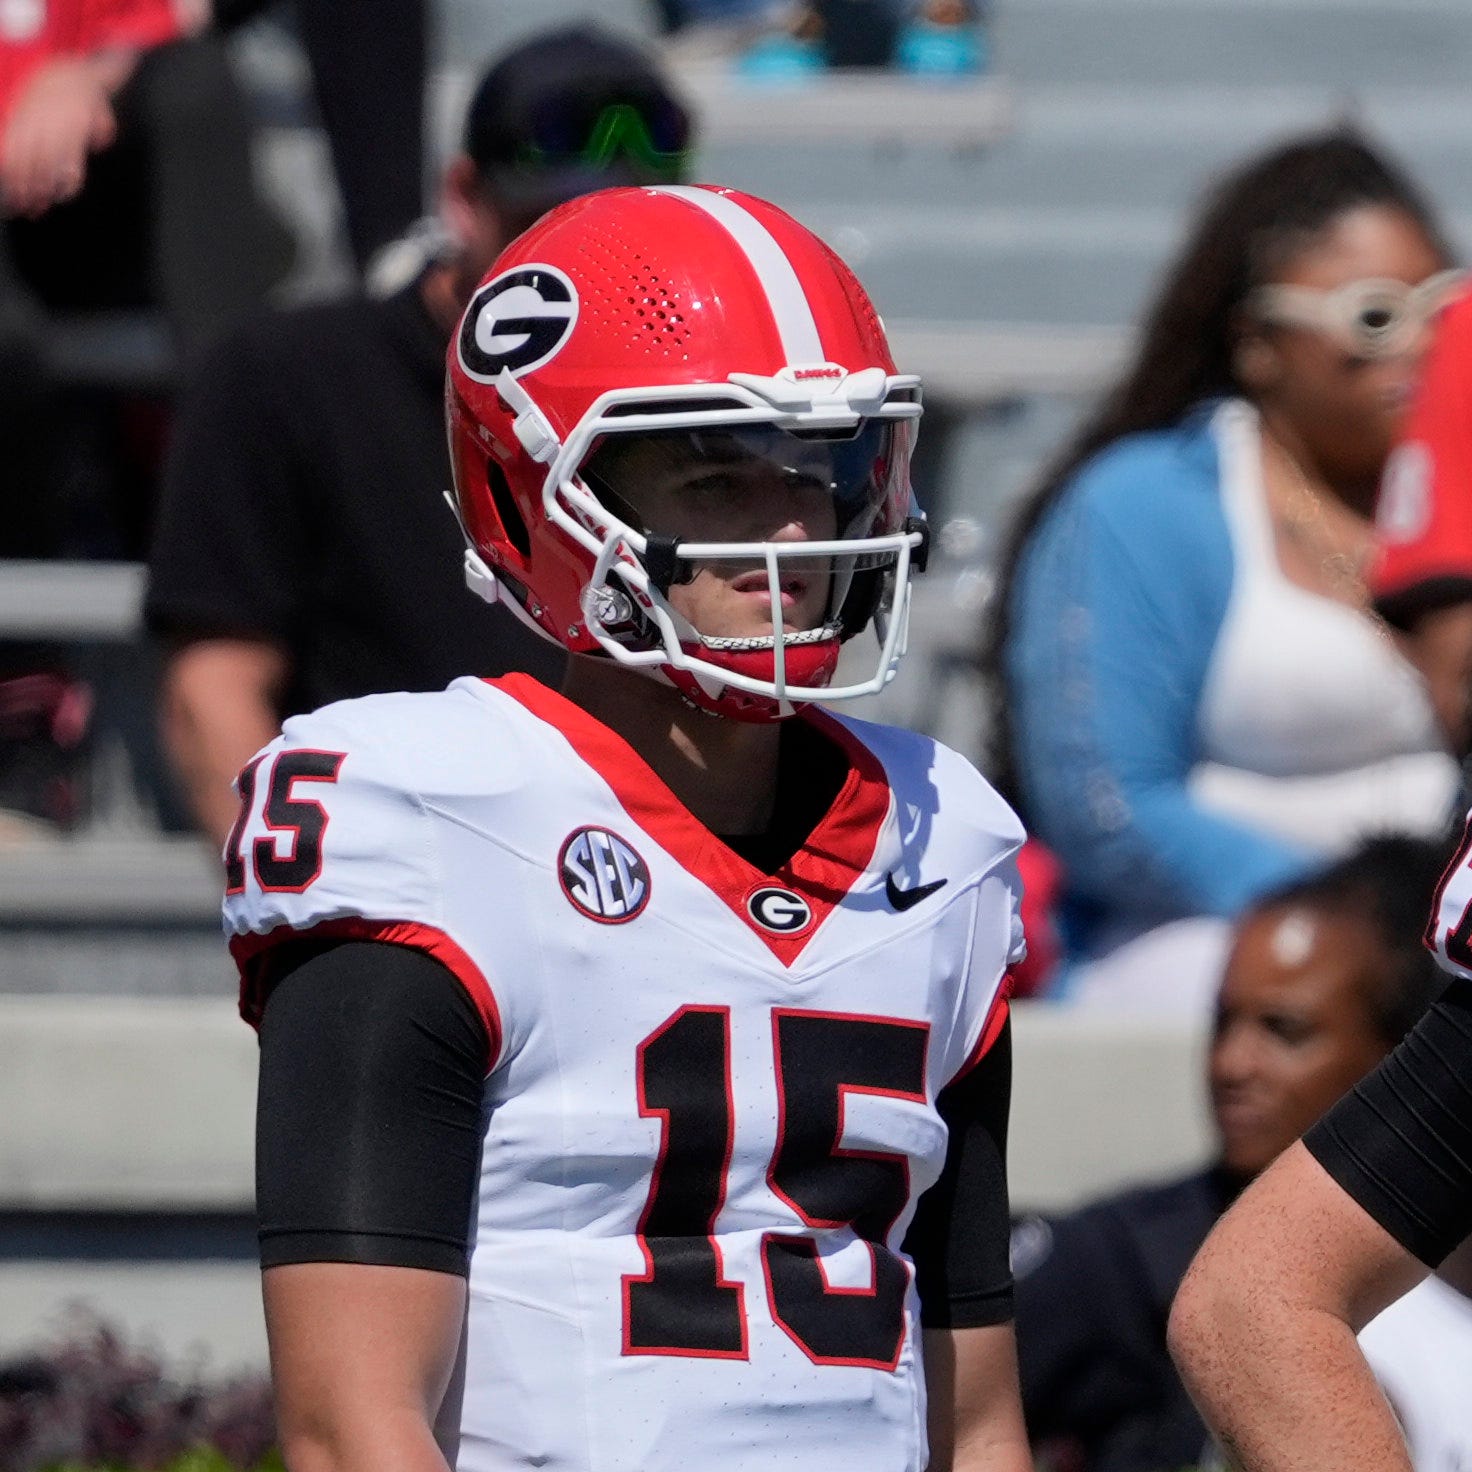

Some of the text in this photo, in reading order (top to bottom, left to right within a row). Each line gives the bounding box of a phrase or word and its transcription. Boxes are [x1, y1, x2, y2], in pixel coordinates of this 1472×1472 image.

[458, 263, 579, 383] G
[224, 748, 349, 895] 15
[561, 829, 647, 918] SEC
[748, 886, 812, 933] G
[621, 1003, 931, 1371] 15
